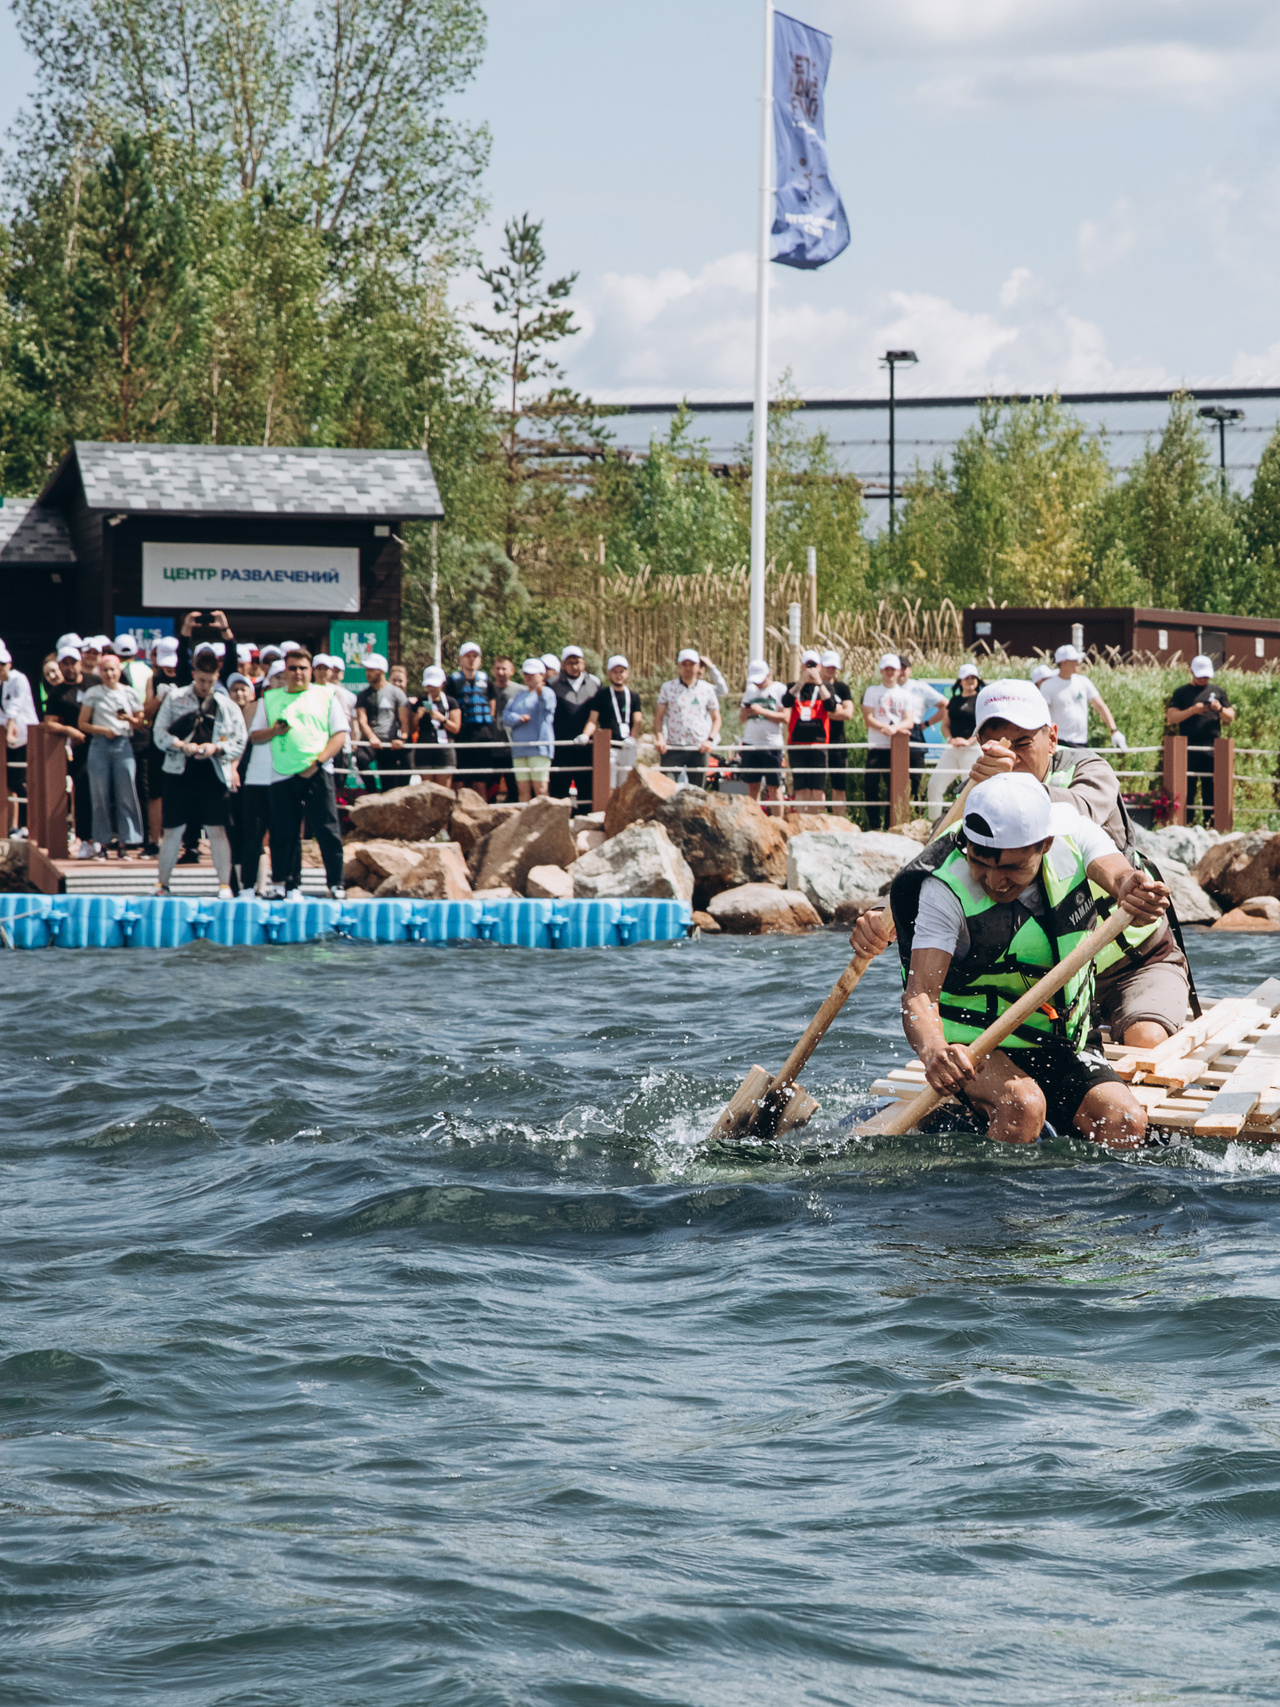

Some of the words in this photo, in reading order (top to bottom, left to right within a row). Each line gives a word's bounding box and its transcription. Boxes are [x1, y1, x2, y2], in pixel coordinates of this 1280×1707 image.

[163, 567, 217, 582] ЦЕНТР
[221, 568, 340, 583] РАЗВЛЕЧЕНИЙ
[1069, 896, 1095, 926] YAMAH
